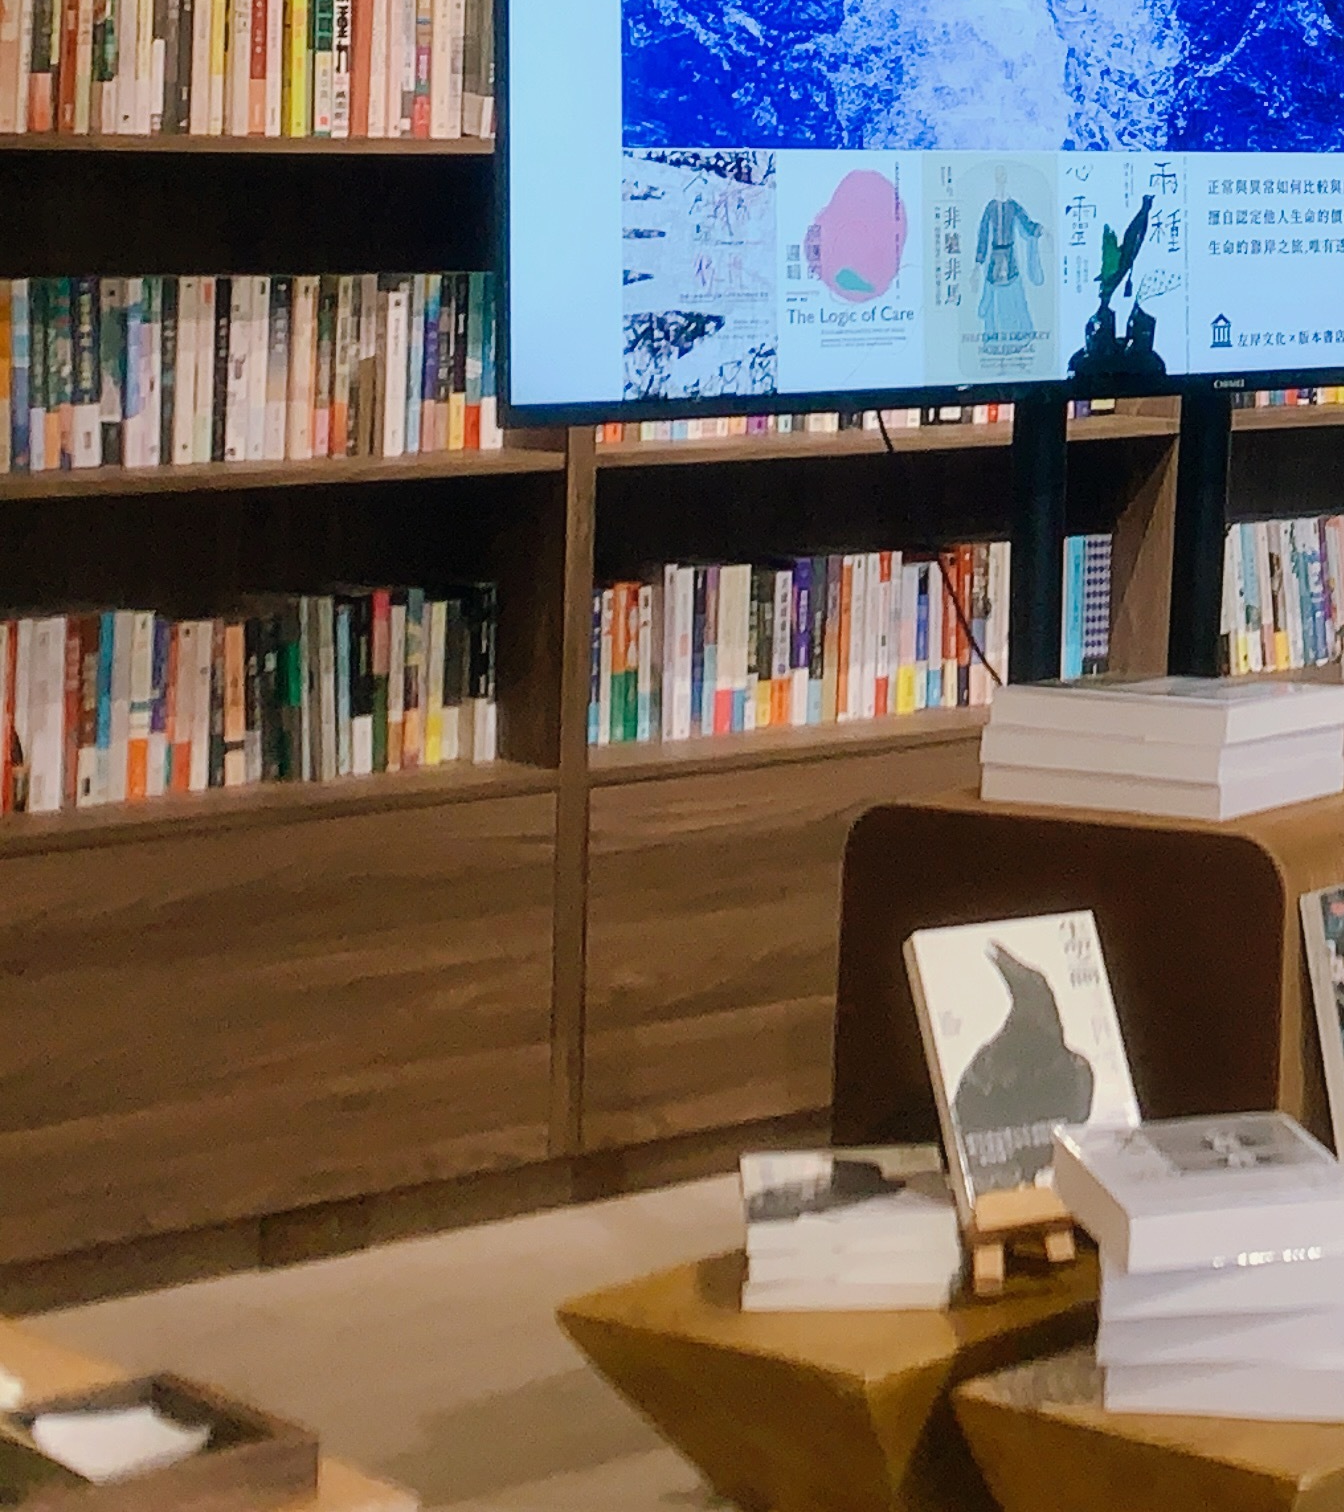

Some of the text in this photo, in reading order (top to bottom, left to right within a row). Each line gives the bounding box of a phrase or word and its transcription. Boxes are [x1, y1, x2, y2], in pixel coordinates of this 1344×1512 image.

[786, 305, 915, 327] The Logic of Care
